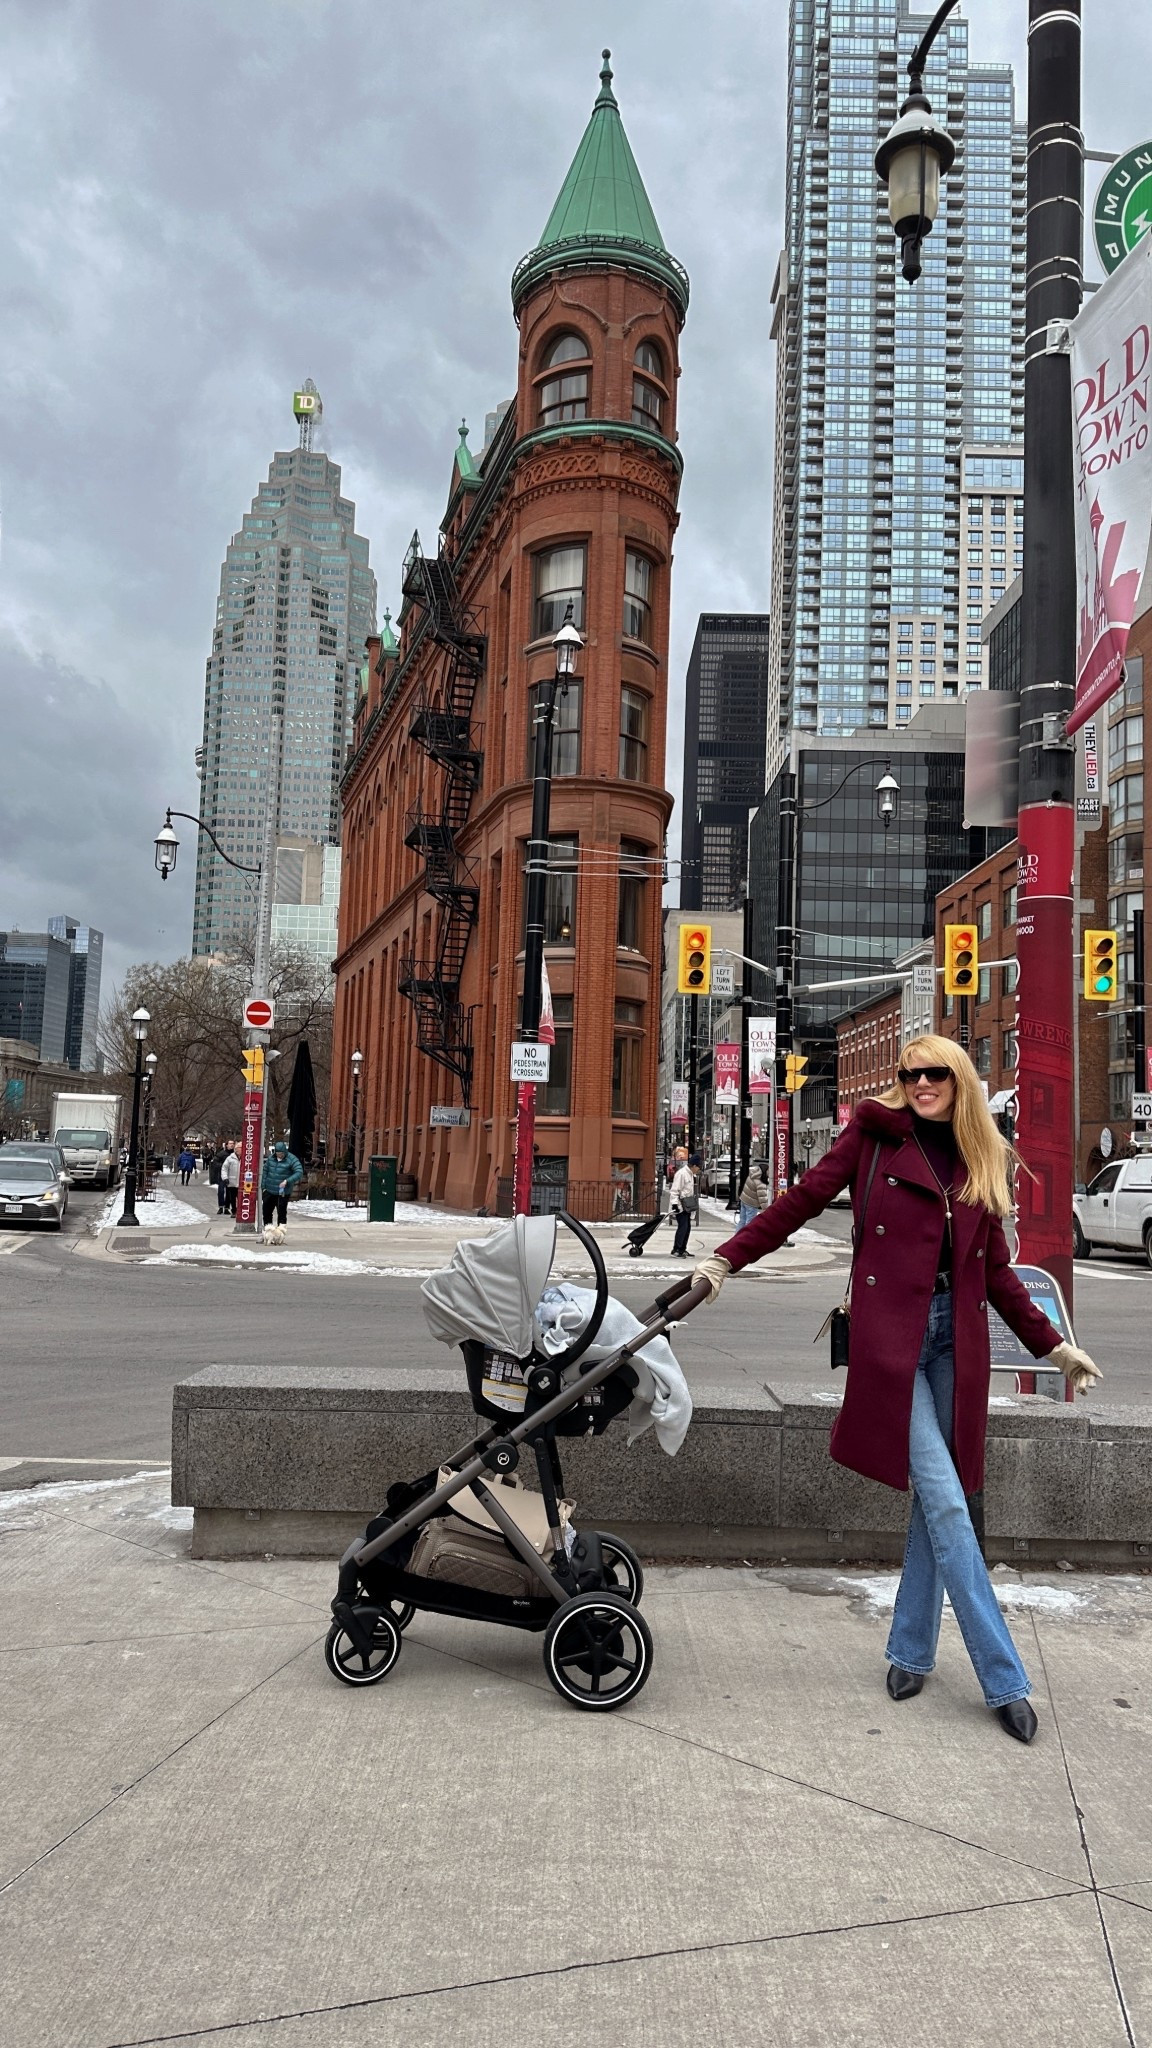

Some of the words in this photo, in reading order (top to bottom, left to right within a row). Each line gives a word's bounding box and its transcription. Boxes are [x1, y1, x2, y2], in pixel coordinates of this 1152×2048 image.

[296, 395, 315, 409] TD
[1076, 374, 1150, 455] OWN
[1085, 724, 1098, 790] THEYLIED.ca
[1017, 867, 1038, 879] OWN
[716, 976, 730, 984] TURN
[713, 984, 732, 992] SIGNAL
[750, 1030, 776, 1041] OLD
[524, 1047, 537, 1058] NO
[716, 1053, 739, 1062] OLD
[513, 1059, 547, 1068] PEDESTRIAN
[517, 1068, 543, 1077] CROSSING
[1134, 1104, 1152, 1116] 40
[246, 1124, 254, 1168] TORONTO
[777, 1132, 786, 1176] TORONTO
[241, 1199, 251, 1220] OLD
